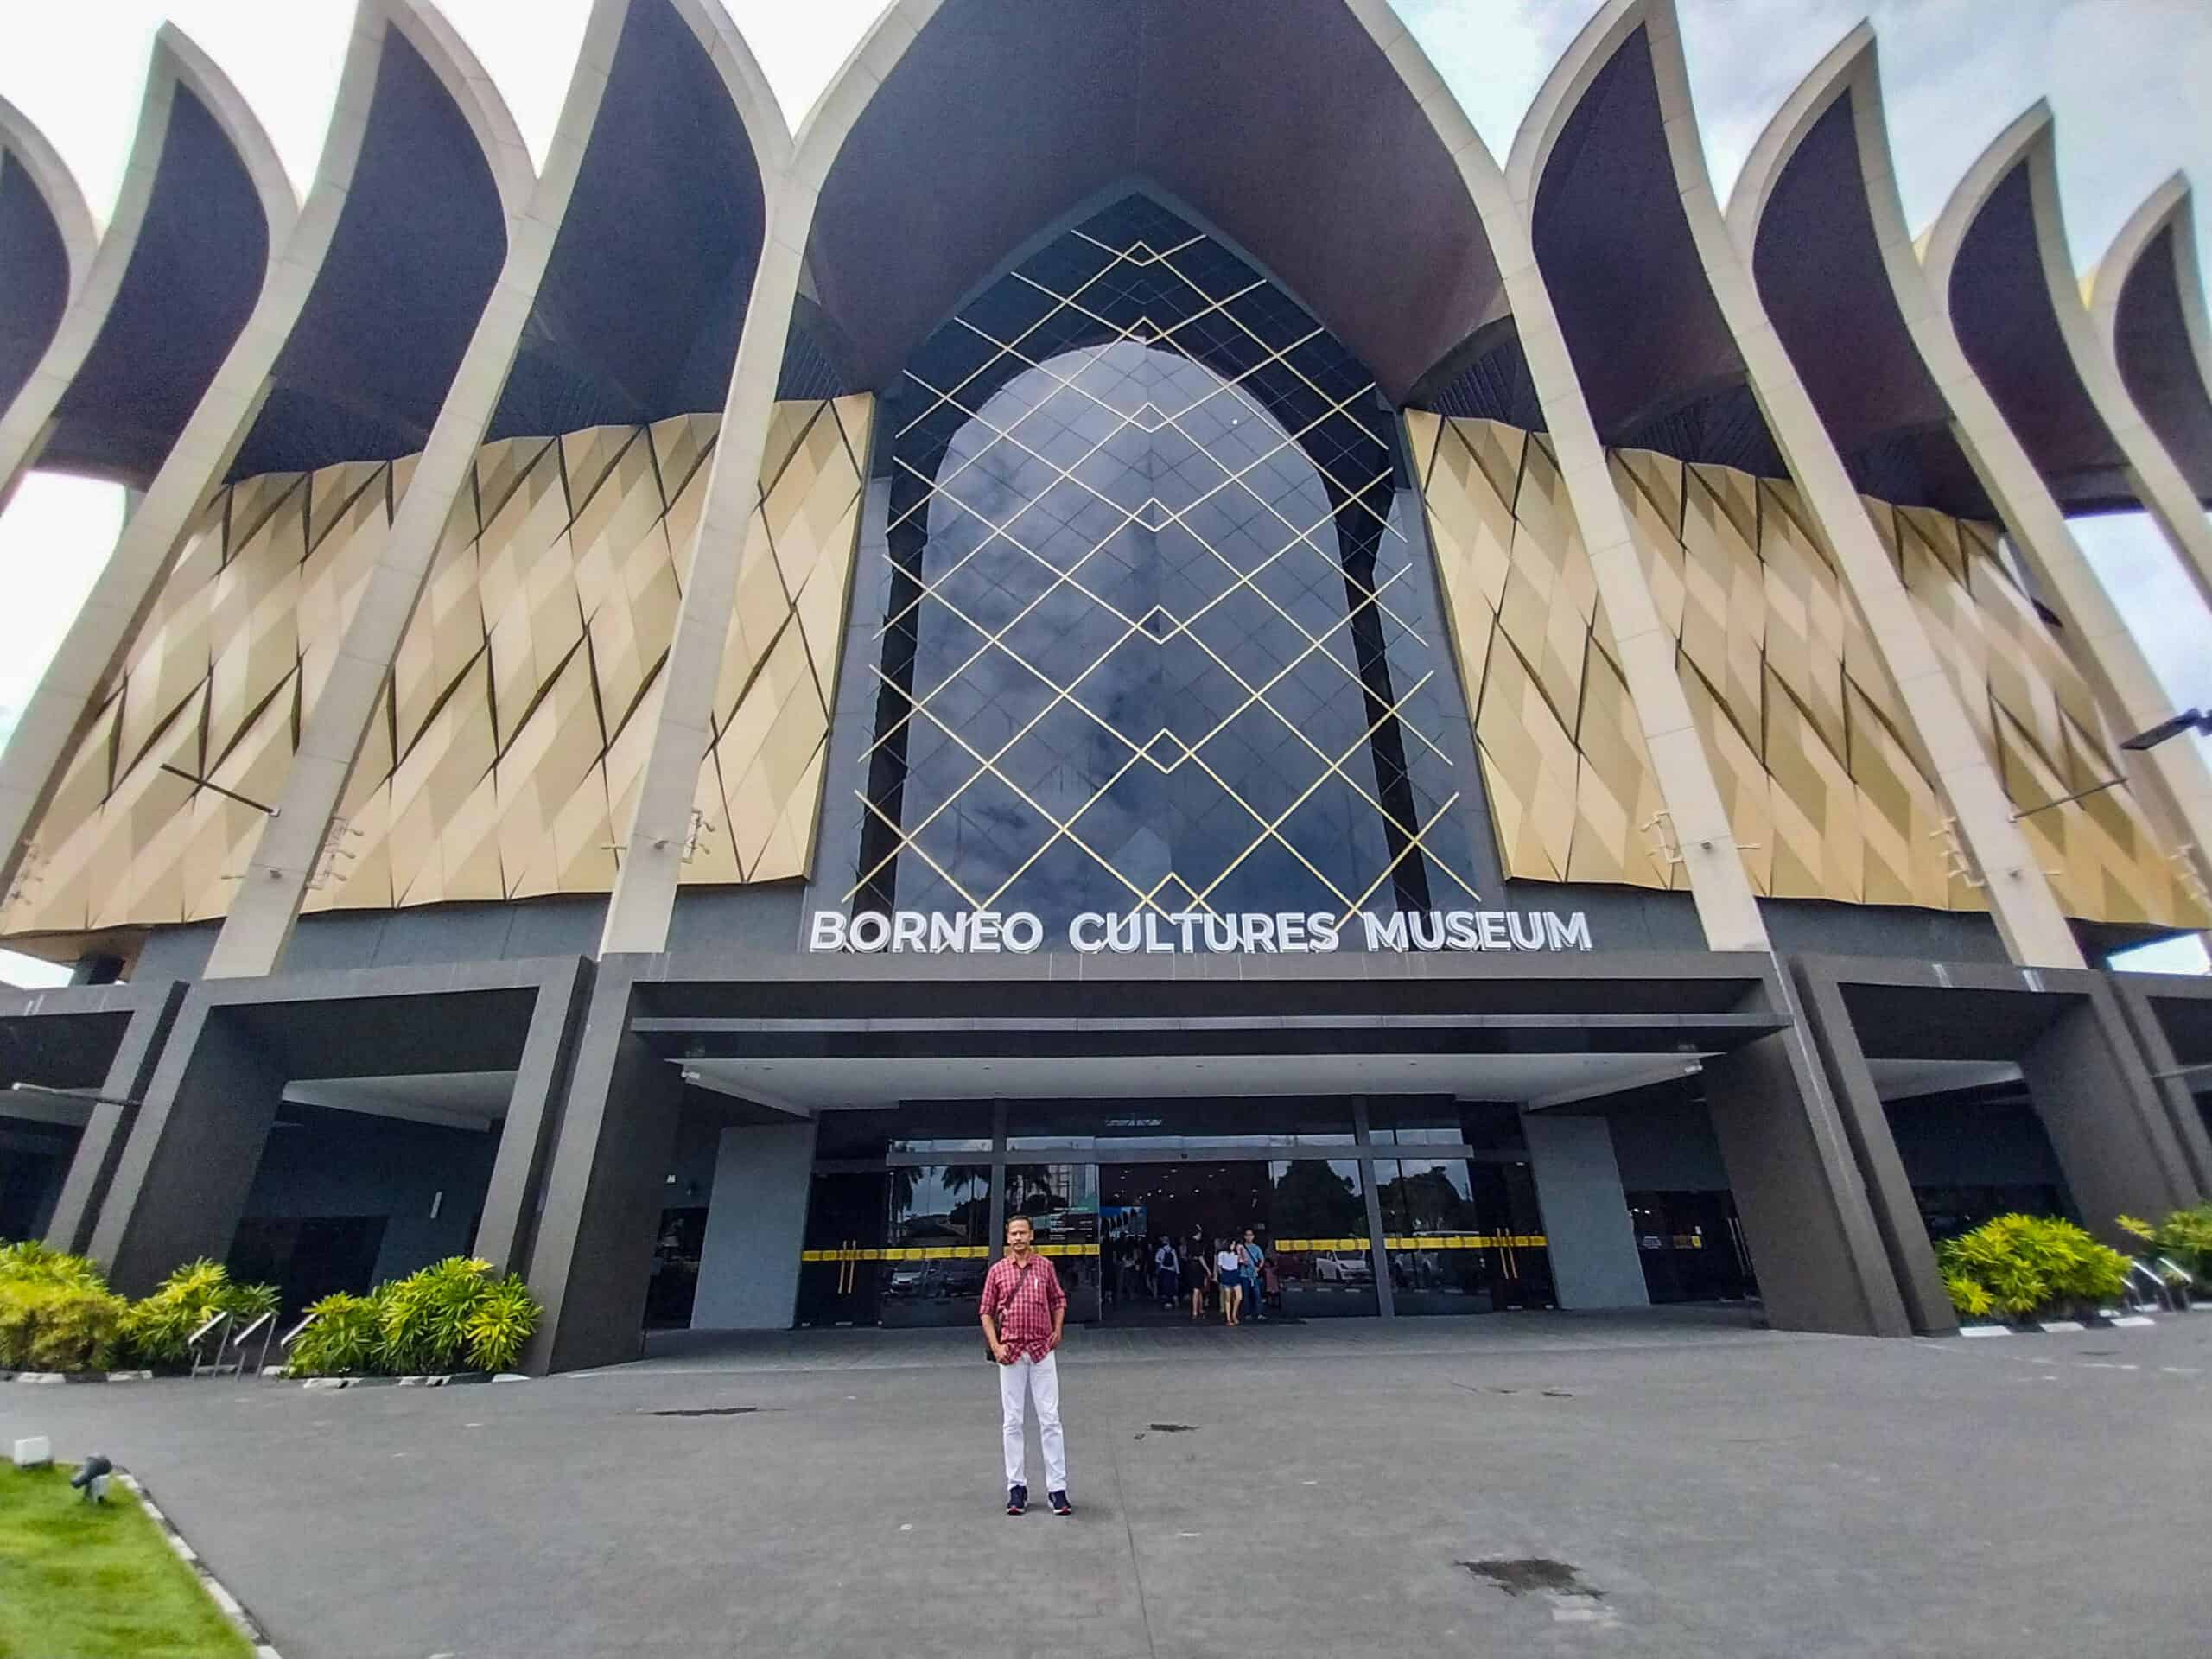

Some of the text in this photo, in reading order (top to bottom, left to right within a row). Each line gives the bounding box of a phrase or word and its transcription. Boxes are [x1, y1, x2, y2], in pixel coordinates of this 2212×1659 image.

[809, 911, 1592, 954] BORNEO CULTURES MUSEUM
